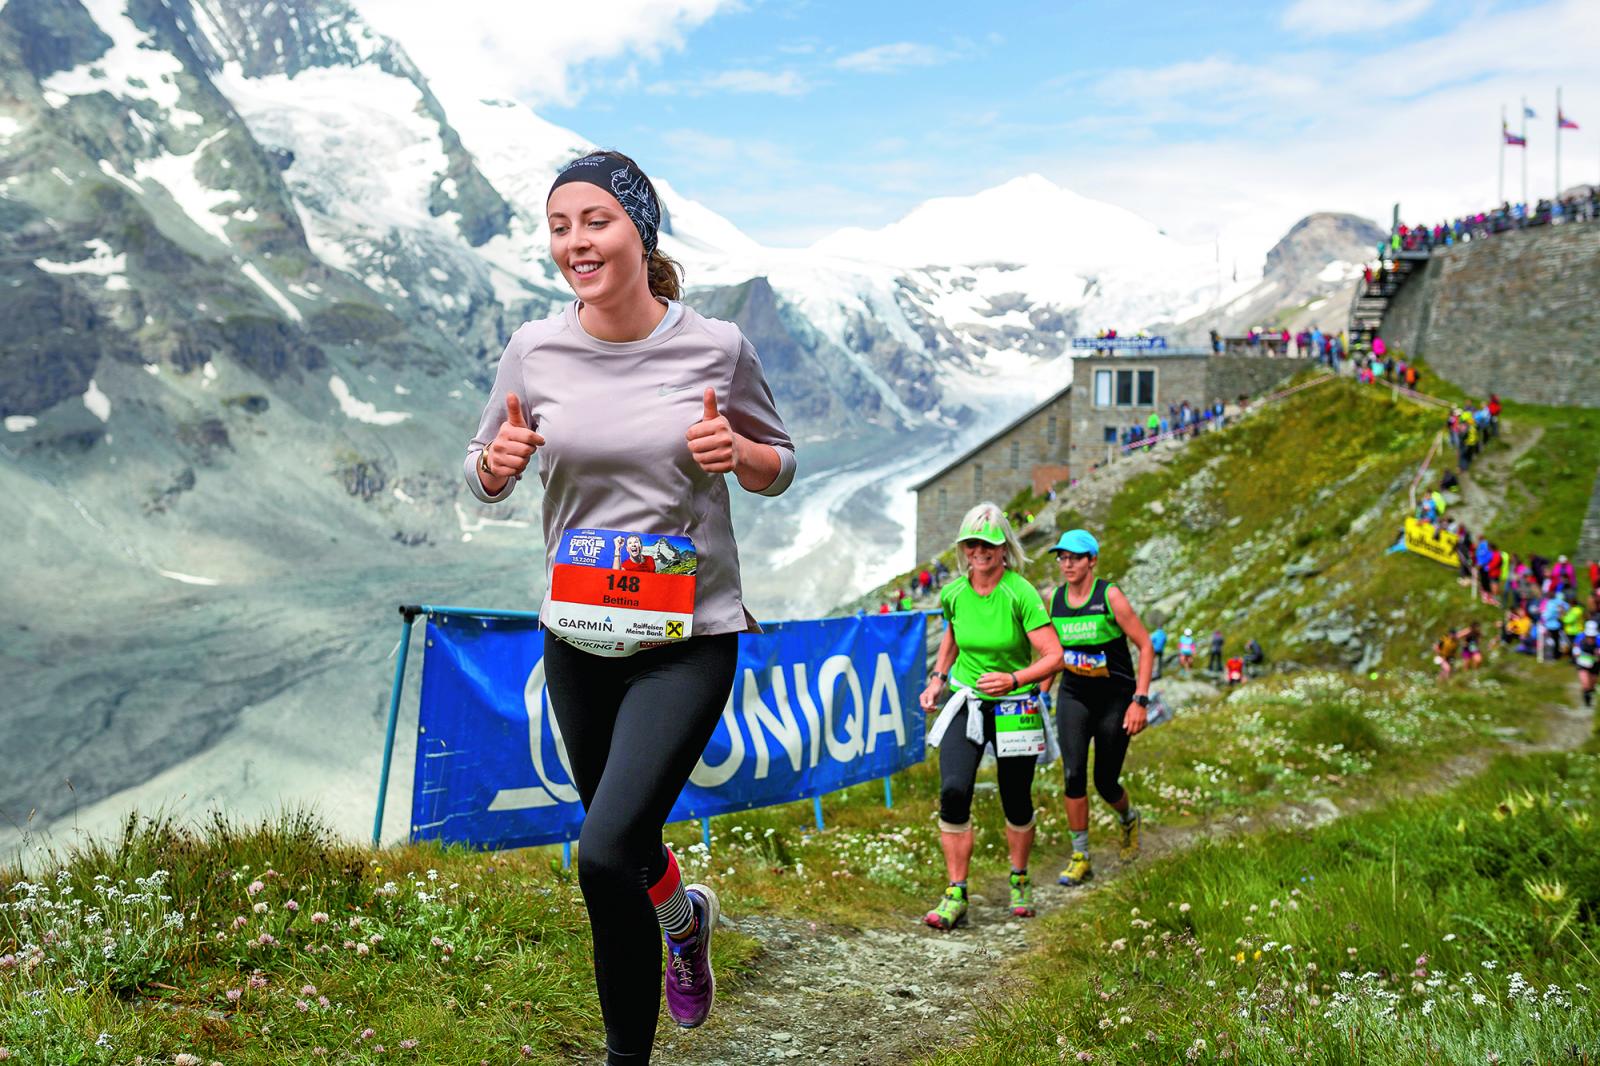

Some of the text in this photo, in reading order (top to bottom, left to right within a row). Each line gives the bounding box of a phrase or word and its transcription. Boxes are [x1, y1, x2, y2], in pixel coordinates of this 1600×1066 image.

[570, 538, 595, 547] BERG
[569, 545, 601, 558] LAUF
[606, 574, 640, 593] 148
[603, 594, 639, 607] Bettina
[558, 617, 614, 633] GARMIN
[633, 622, 664, 631] Raiffeisen
[1061, 622, 1097, 633] VEGAN
[626, 628, 645, 636] Meine
[577, 641, 613, 651] VIKING
